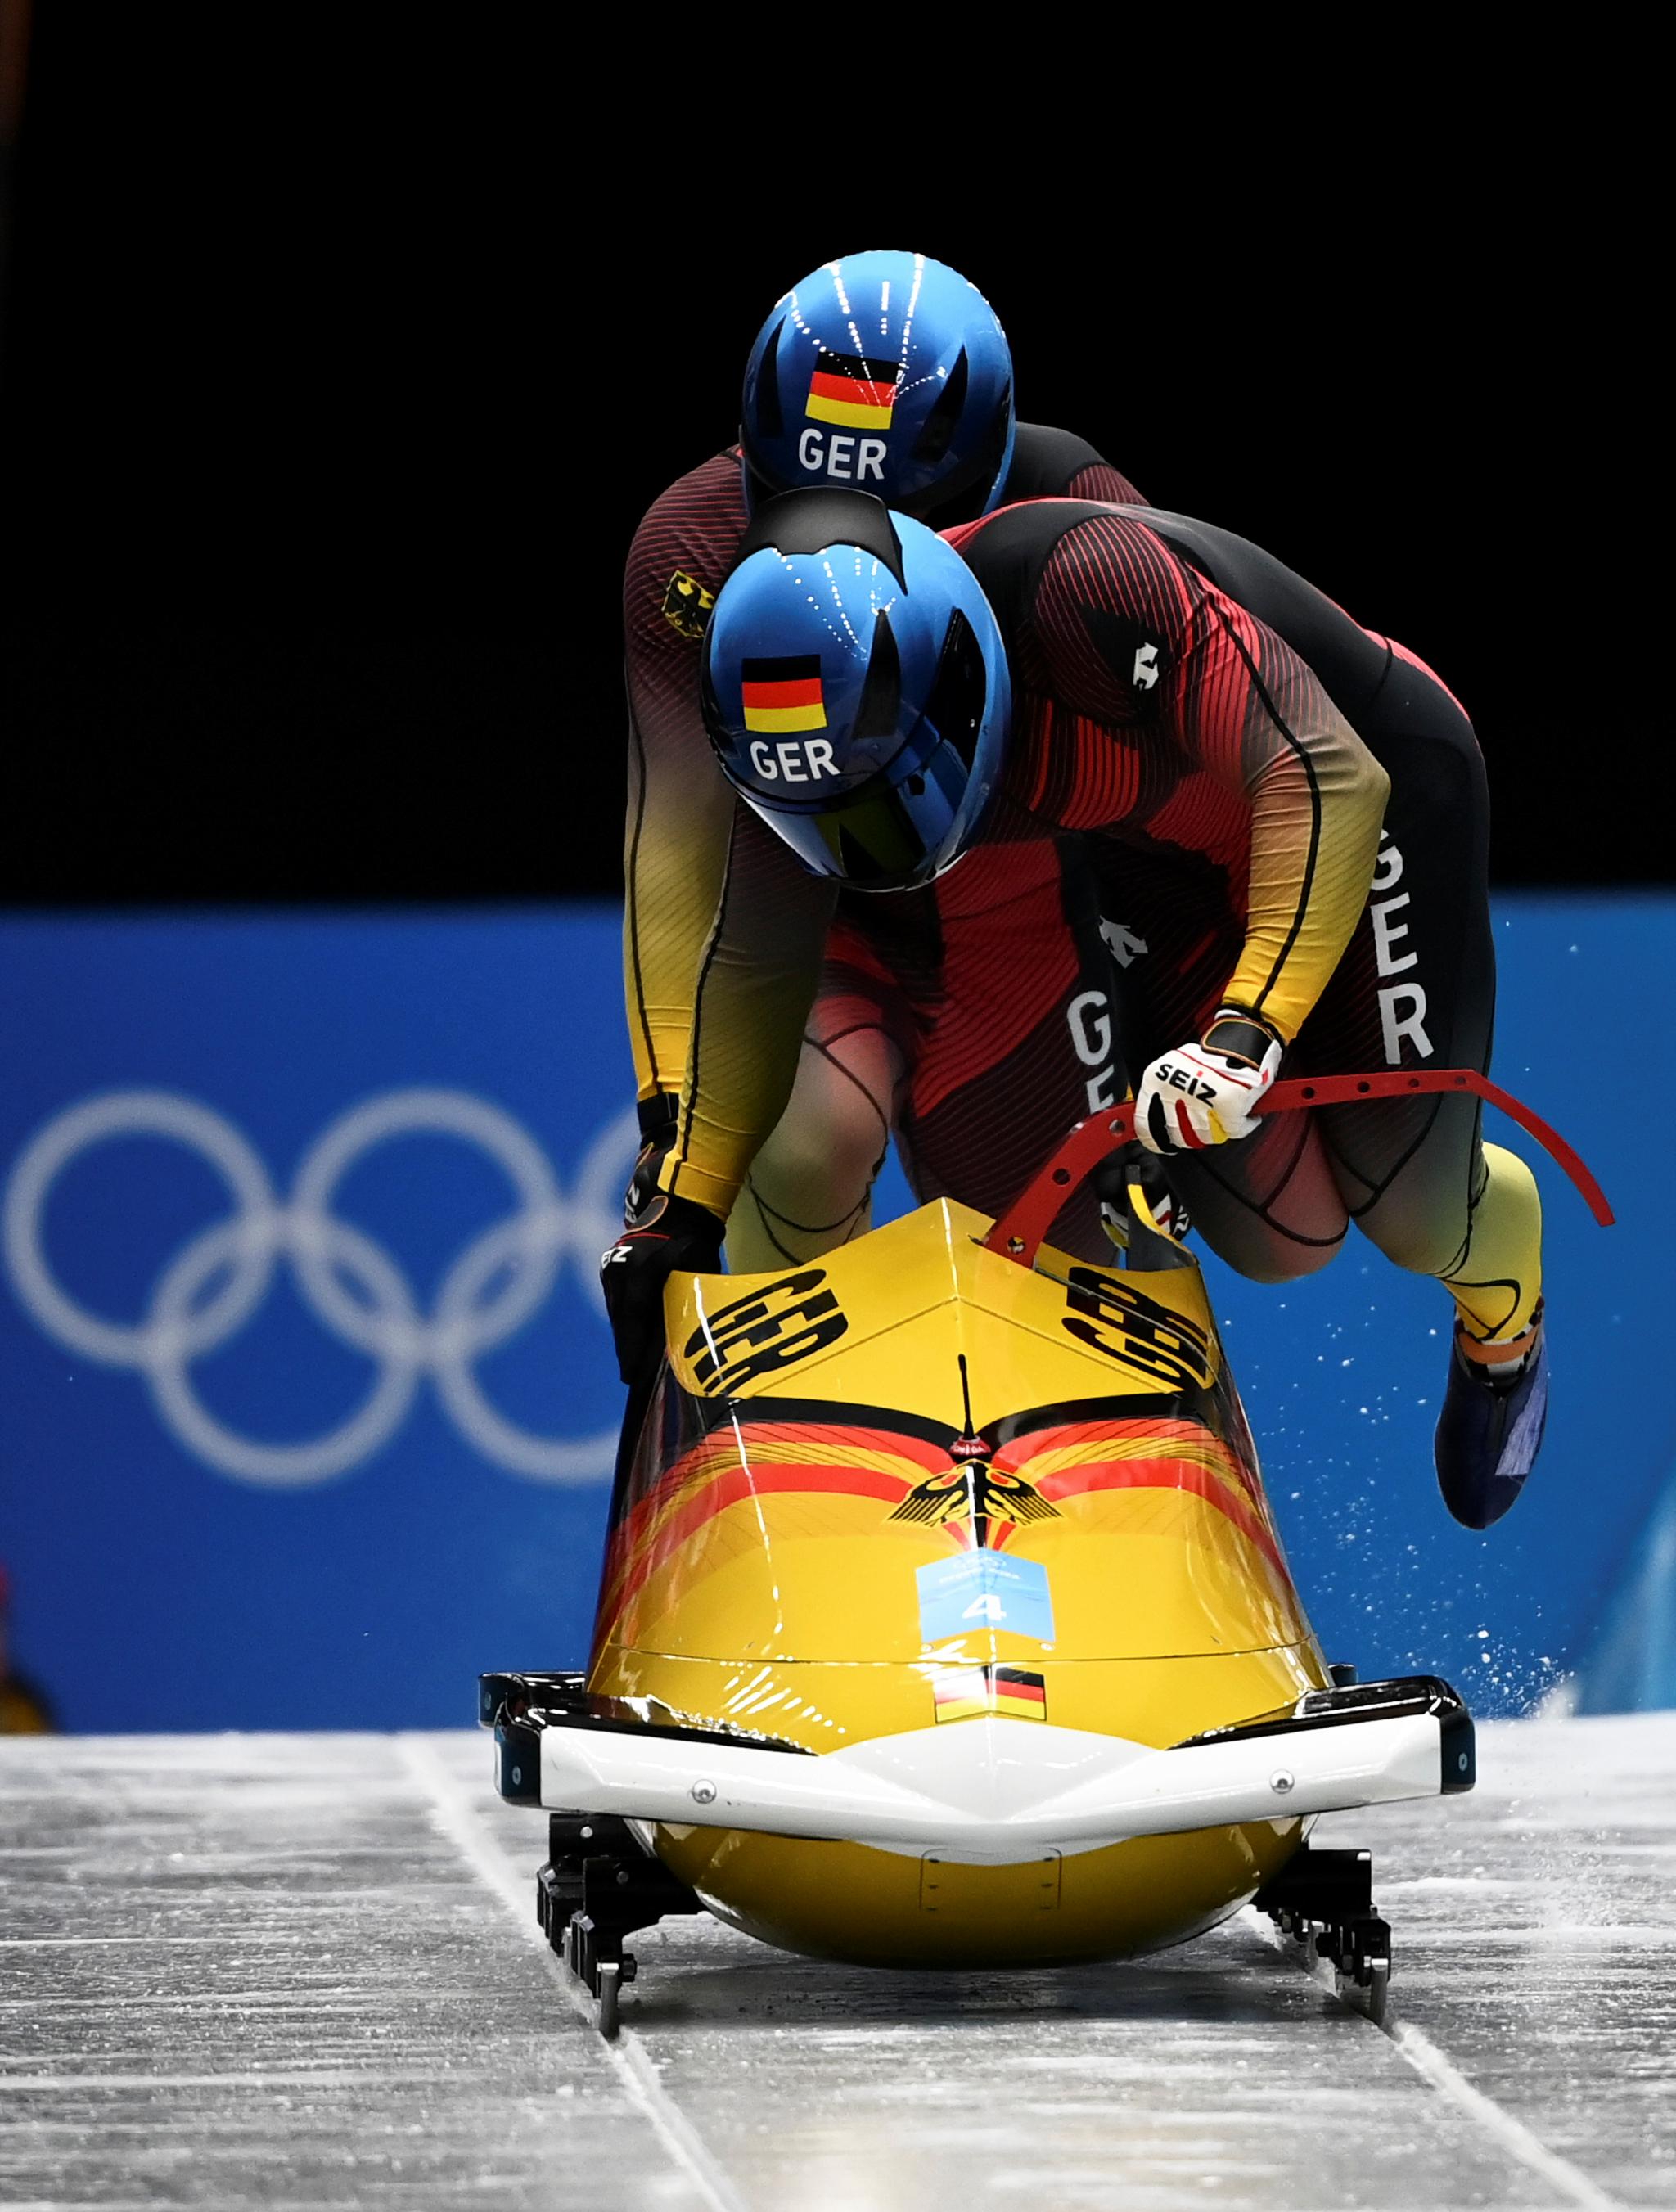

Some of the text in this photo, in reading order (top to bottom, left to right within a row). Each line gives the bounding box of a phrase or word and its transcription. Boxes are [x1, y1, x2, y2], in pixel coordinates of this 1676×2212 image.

[799, 428, 887, 480] GER
[750, 738, 841, 782] GER
[1067, 990, 1115, 1115] GE
[684, 1268, 849, 1396] GER
[1061, 1266, 1208, 1391] GER
[962, 1593, 1007, 1621] 4
